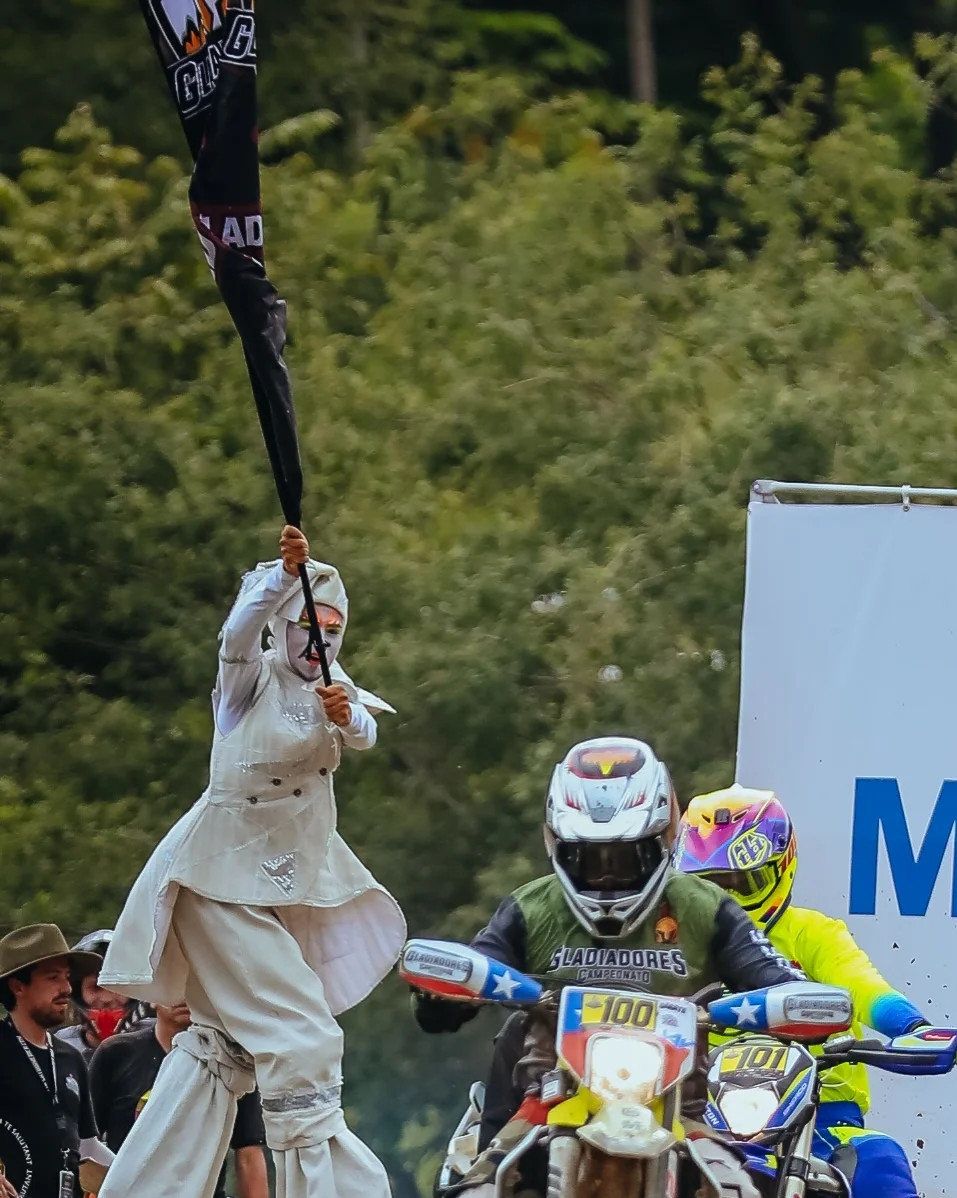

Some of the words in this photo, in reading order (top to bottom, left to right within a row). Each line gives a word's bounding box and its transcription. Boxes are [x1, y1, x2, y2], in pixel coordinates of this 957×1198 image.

[547, 945, 689, 977] GLADIADORES
[576, 968, 651, 985] CAMPEONATO
[600, 995, 655, 1028] 100
[738, 1046, 787, 1072] 101
[11, 1128, 33, 1166] SALUTANT
